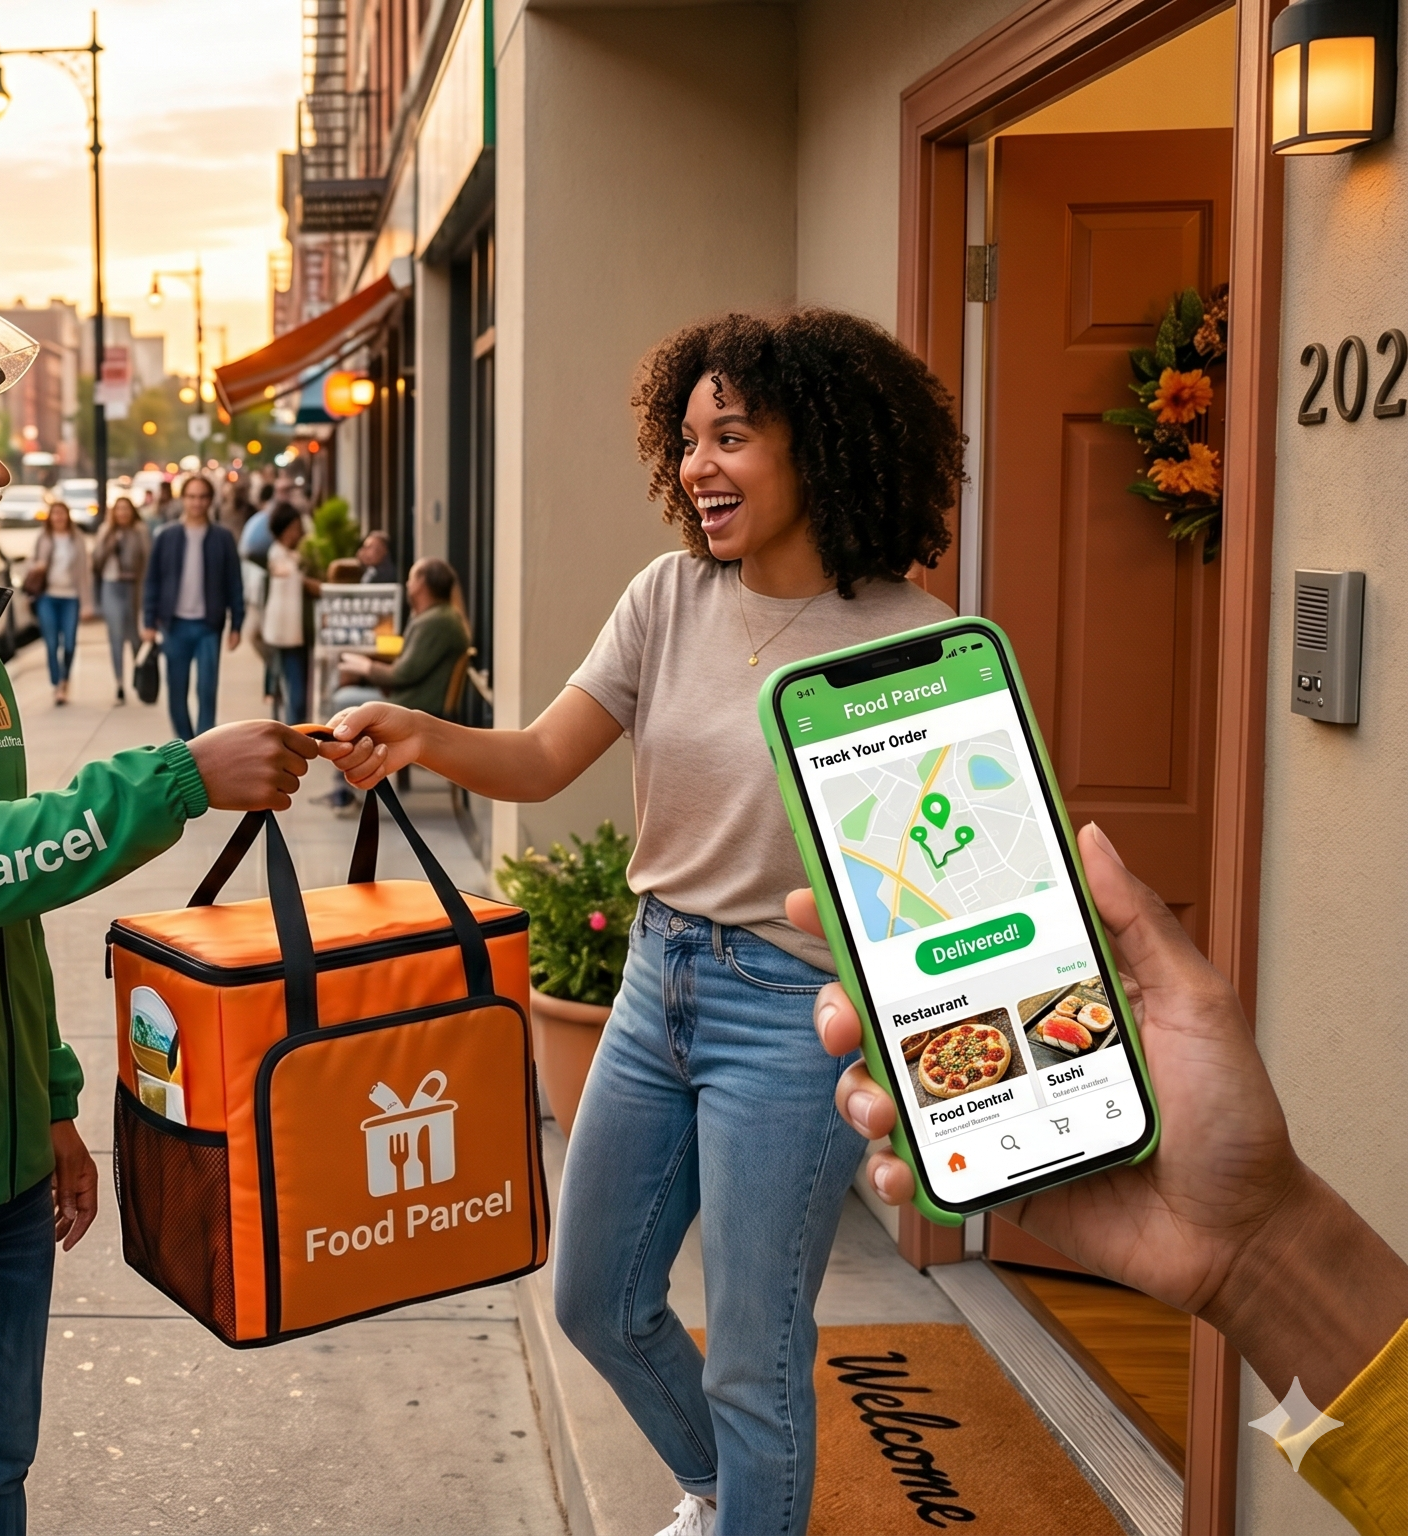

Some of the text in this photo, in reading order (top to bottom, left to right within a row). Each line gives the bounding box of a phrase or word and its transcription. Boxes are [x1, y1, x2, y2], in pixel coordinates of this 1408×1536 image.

[1298, 328, 1408, 425] 202
[843, 676, 948, 720] Food Parcel
[809, 728, 928, 769] Track Your Order
[932, 923, 1020, 964] Delivered!
[892, 994, 969, 1028] Restaurant
[1047, 1065, 1084, 1087] Sushi
[930, 1104, 965, 1125] Food
[966, 1088, 1014, 1113] Dentral
[306, 1180, 512, 1262] Food Parcel
[826, 1351, 976, 1528] Welcome
